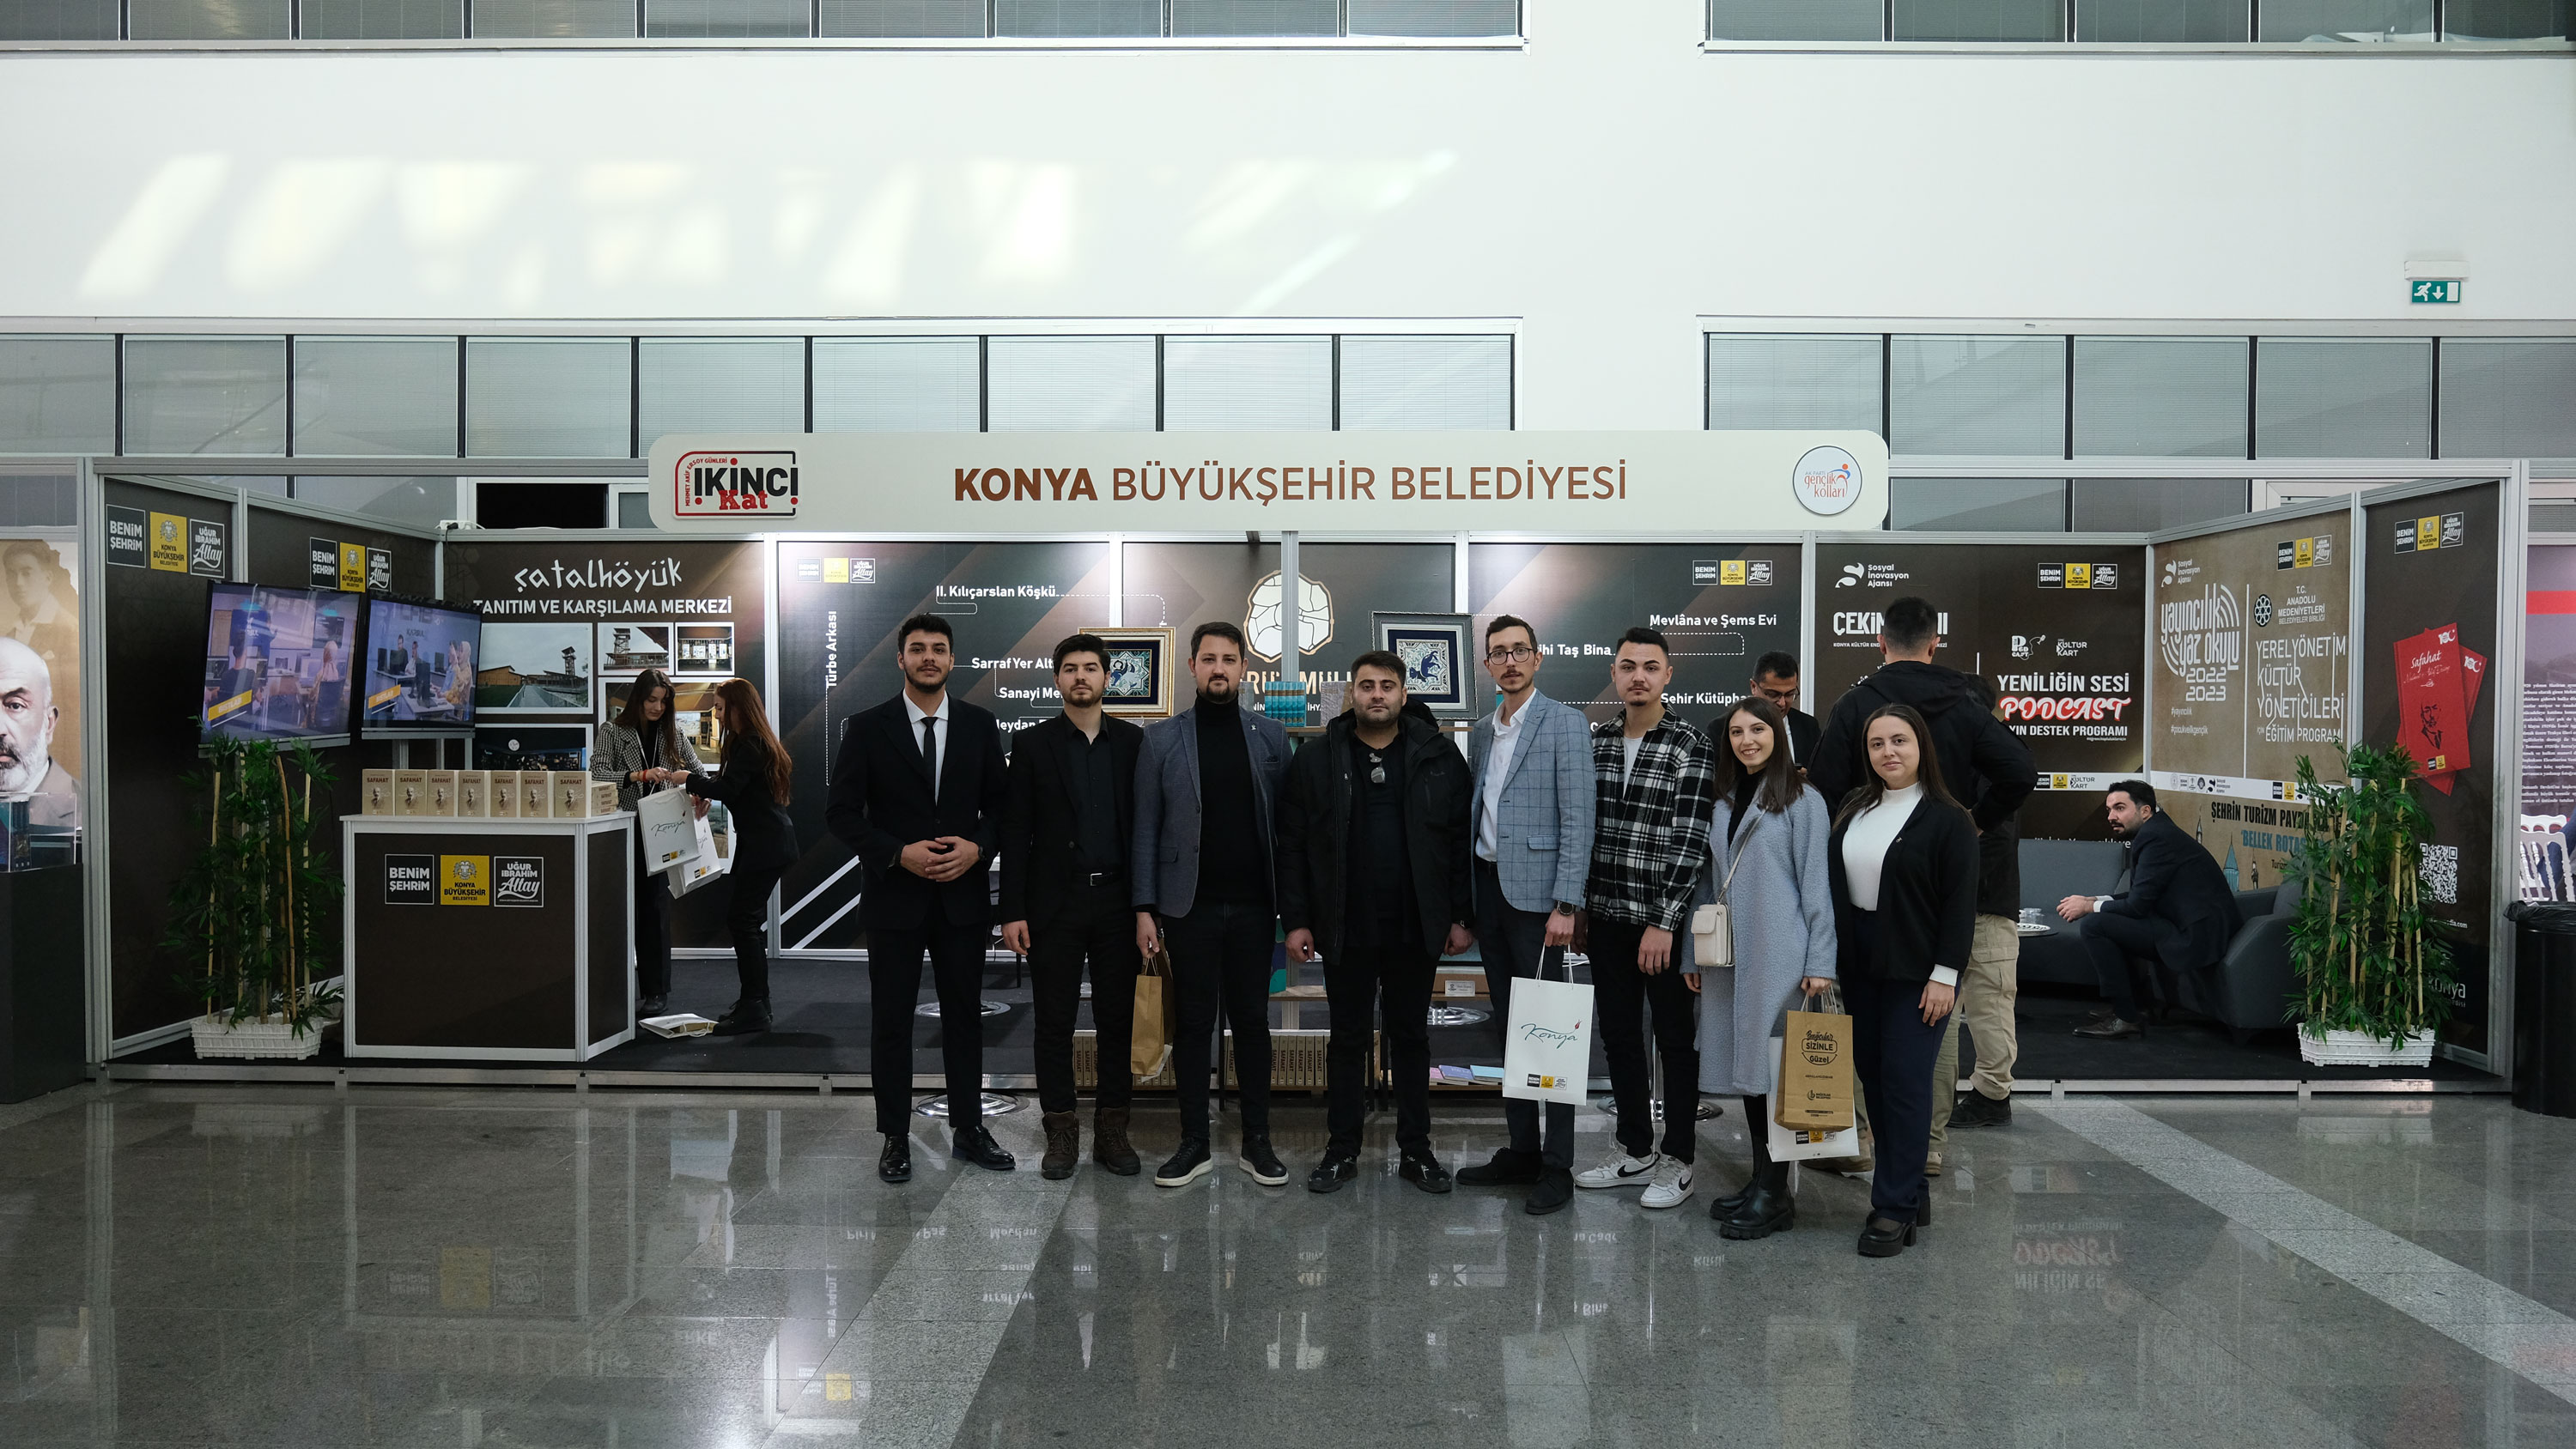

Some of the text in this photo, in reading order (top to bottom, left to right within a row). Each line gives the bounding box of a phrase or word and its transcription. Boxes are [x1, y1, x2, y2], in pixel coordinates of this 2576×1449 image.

[687, 459, 703, 470] ERSOY
[955, 459, 1625, 507] KONYA BÜYÜKŞEHİR BELEDİYESİ
[1804, 473, 1837, 489] gençlik
[1814, 484, 1844, 498] kolları
[719, 489, 768, 510] Kat
[110, 521, 142, 537] BENİM
[199, 526, 216, 537] UĞUR
[111, 537, 142, 551] ŞEHRİM
[193, 545, 222, 567] Altay
[313, 550, 334, 564] BENİM
[313, 564, 334, 575] ŞEHRİM
[2178, 559, 2192, 568] Sosyal
[369, 567, 389, 588] Altay
[515, 558, 682, 592] çatalhöyük
[1749, 571, 1770, 581] Altay
[1868, 572, 1909, 580] İnovasyon
[2094, 574, 2115, 585] Altay
[936, 585, 1055, 599] II. Kılıçarslan Köşkü
[539, 600, 559, 614] VE
[563, 599, 658, 617] KARŞILAMA
[662, 596, 732, 614] MERKEZİ
[2287, 595, 2316, 605] ANADOLU
[2278, 603, 2324, 616] MEDENİYETLERİ
[1650, 614, 1777, 628] Mevlâna ve Şems Evi
[826, 611, 836, 687] Türbe Arkası
[1538, 645, 1611, 658] ihi Taş Bina
[2256, 633, 2346, 658] YEREL YÖNETİM
[2179, 634, 2201, 676] yaz
[2411, 650, 2442, 673] Safahat
[972, 658, 1054, 669] Sarraf Yer Alt
[2186, 667, 2226, 682] 2022
[2257, 663, 2301, 686] KÜLTÜR
[1997, 672, 2129, 692] YENİLİĞİN SESİ
[999, 688, 1040, 701] Sanayi
[2186, 686, 2226, 701] 2023
[1308, 702, 1321, 711] İHY
[2000, 696, 2131, 721] PODCAST
[2257, 693, 2343, 718] YÖNETİCİLERİ
[2009, 725, 2127, 736] YIN DESTEK PROGRAMI
[2266, 724, 2293, 742] EĞİTİM
[2212, 801, 2240, 822] ŞEHRİN
[2244, 804, 2276, 825] TURİZM
[390, 867, 429, 878] BENİM
[390, 881, 429, 892] ŞEHRİM
[444, 888, 485, 896] BÜYÜKŞEHİR
[497, 877, 540, 899] Altay
[1521, 1023, 1577, 1049] Konya
[1807, 1041, 1833, 1051] SİZİNLE
